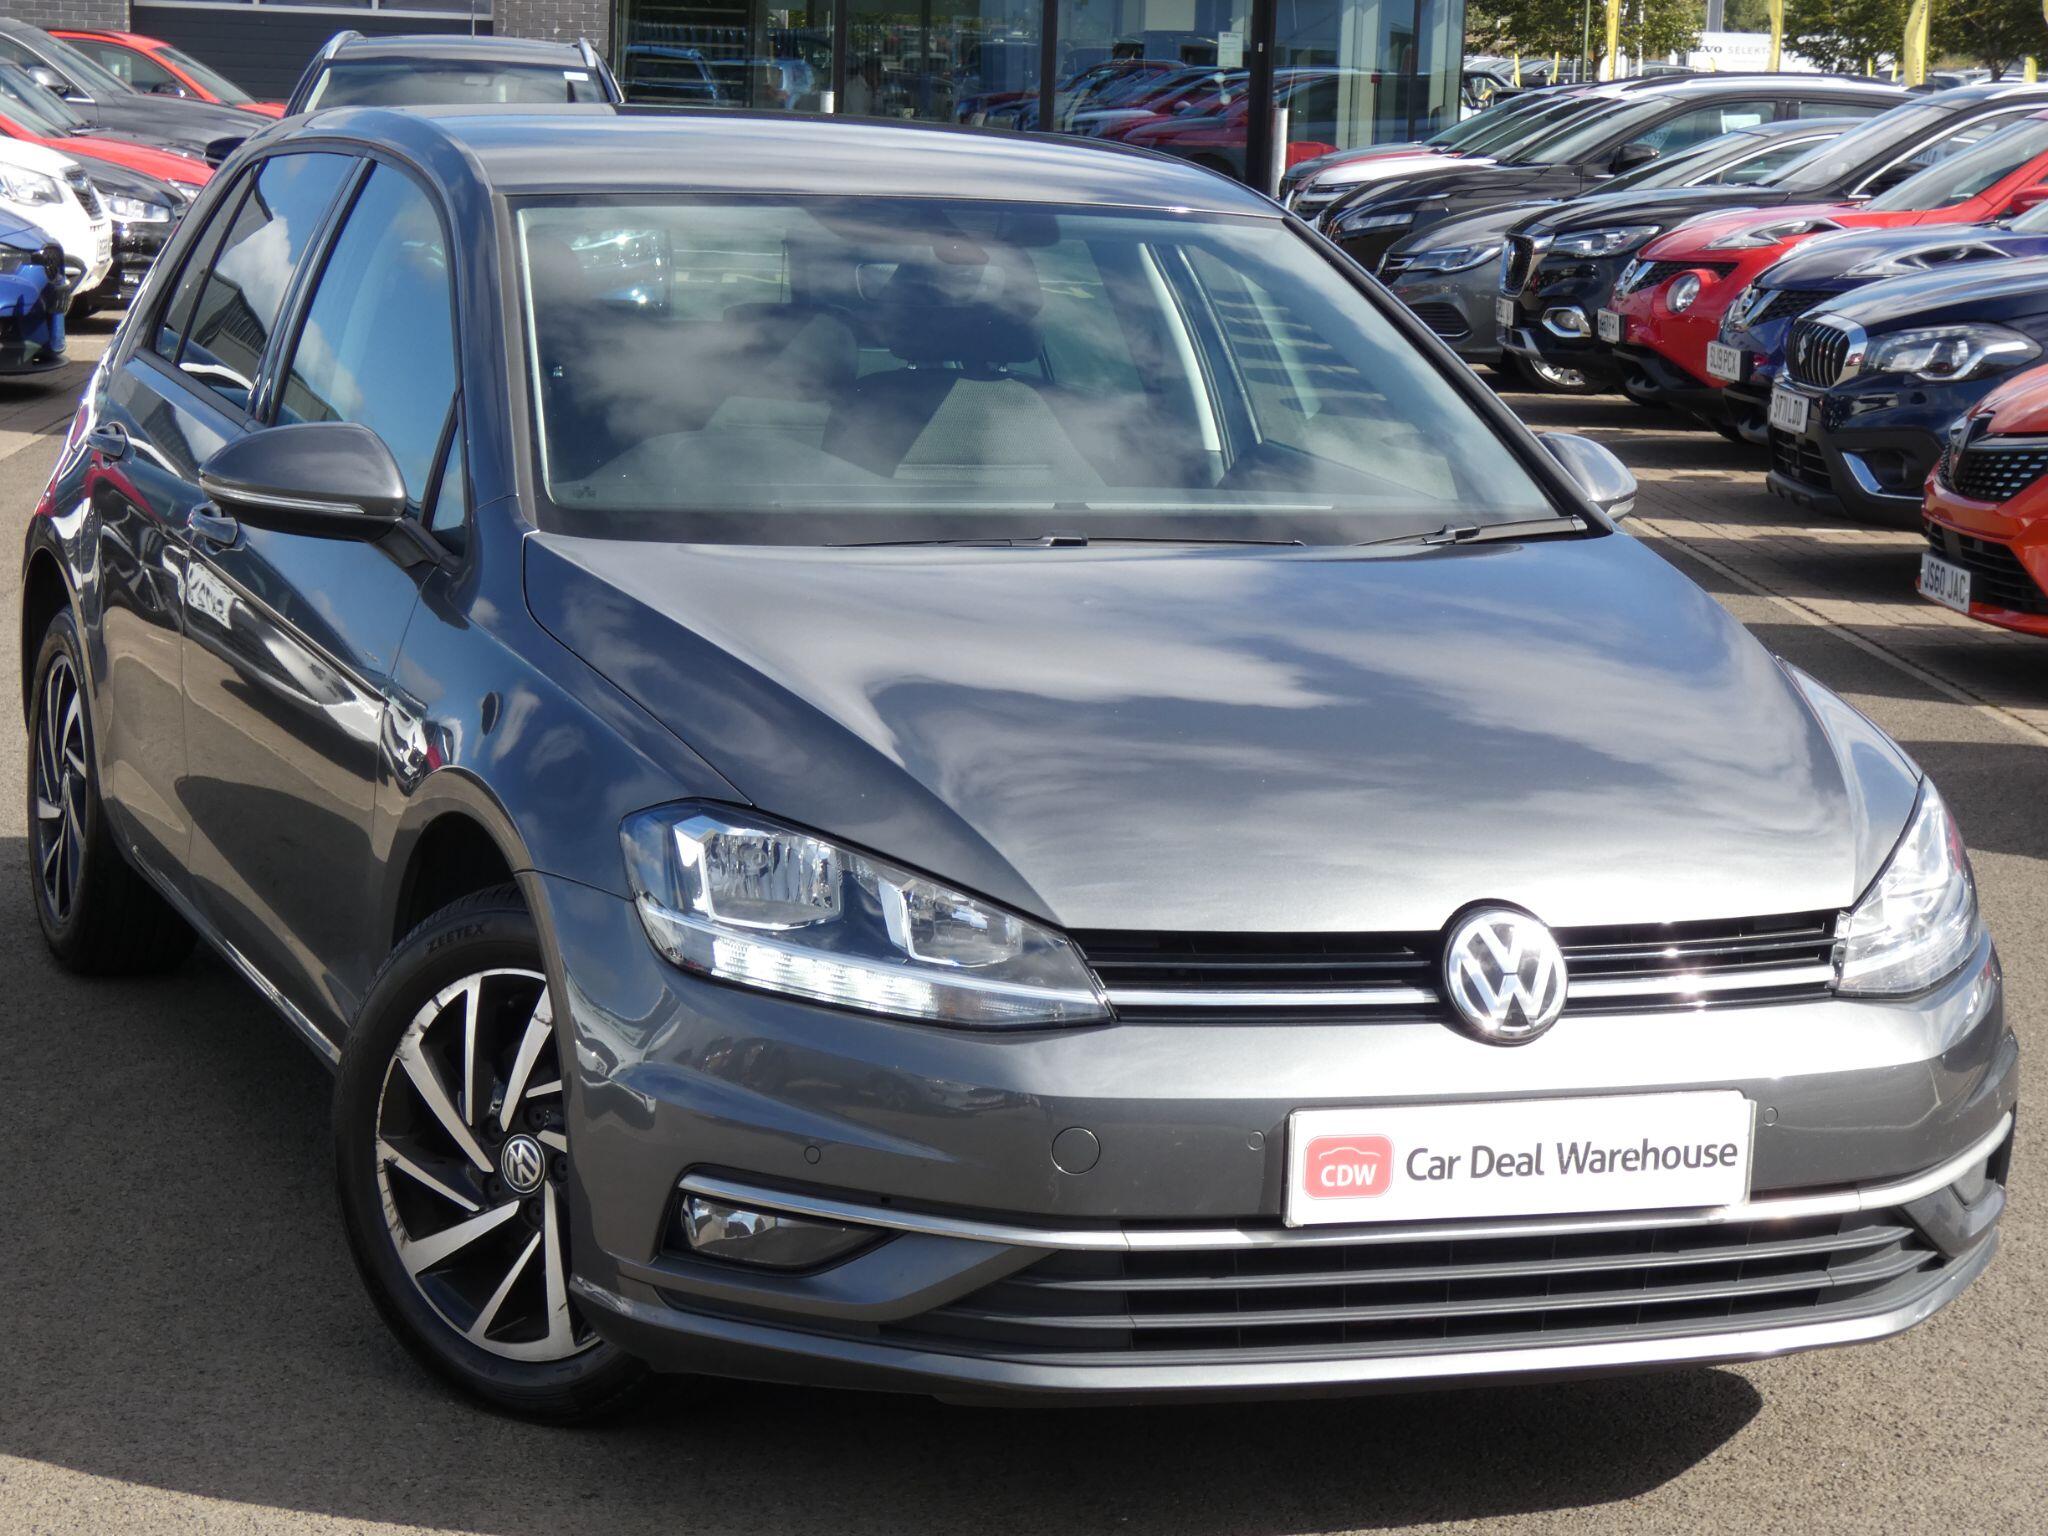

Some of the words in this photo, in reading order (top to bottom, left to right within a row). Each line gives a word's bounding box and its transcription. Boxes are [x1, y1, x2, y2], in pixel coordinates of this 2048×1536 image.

[1925, 560, 1945, 595] JS60
[1947, 570, 1966, 604] JAC
[427, 923, 485, 954] ZEETEX
[1321, 1164, 1376, 1187] CDW
[1406, 1147, 1461, 1181] Car
[1470, 1143, 1544, 1178] Deal
[1557, 1138, 1738, 1175] Warehouse
